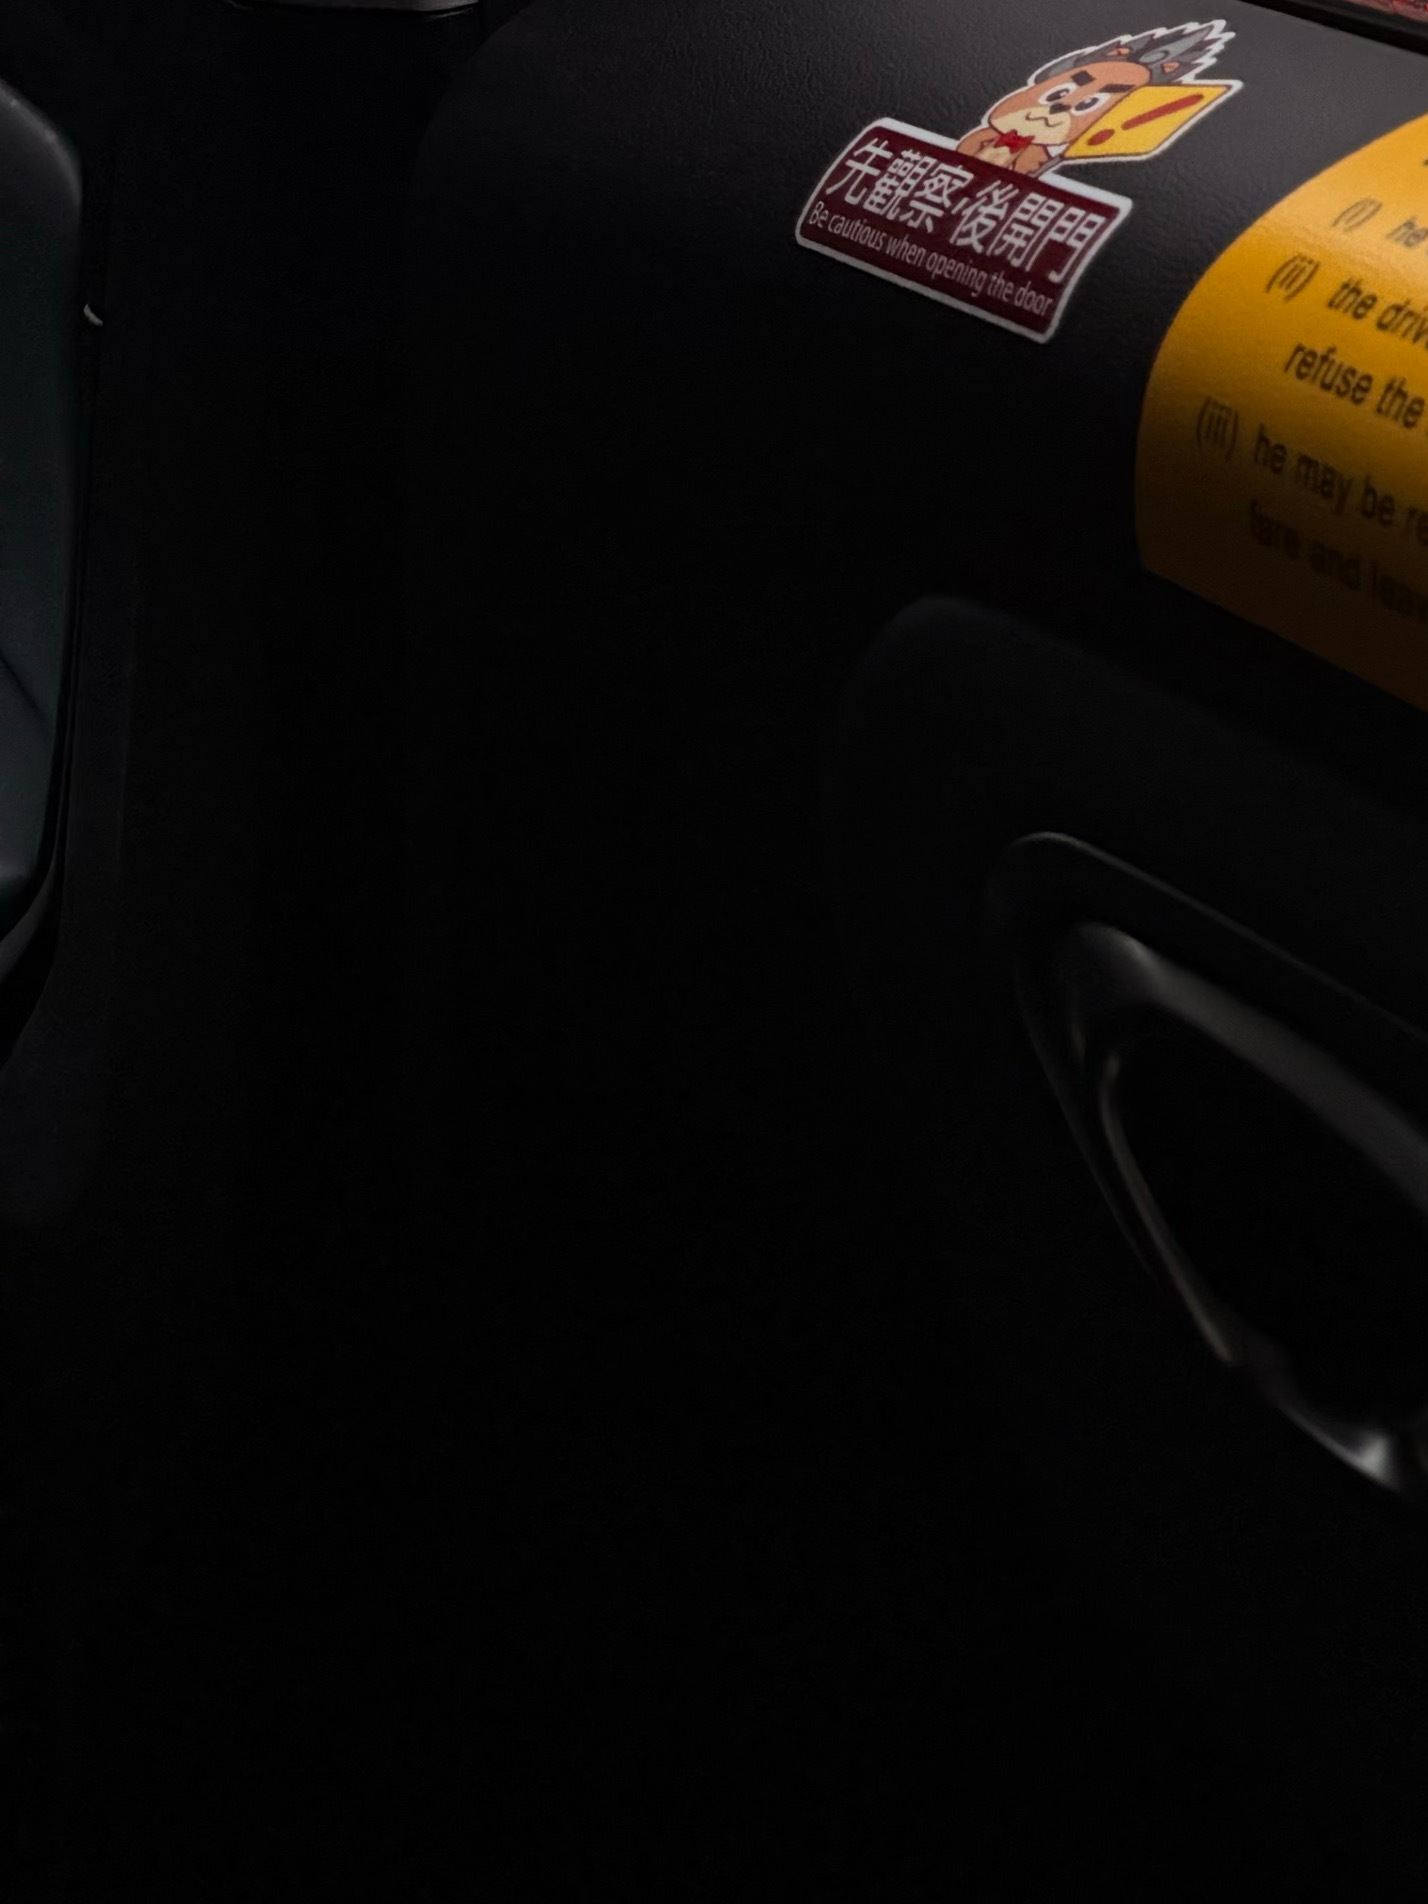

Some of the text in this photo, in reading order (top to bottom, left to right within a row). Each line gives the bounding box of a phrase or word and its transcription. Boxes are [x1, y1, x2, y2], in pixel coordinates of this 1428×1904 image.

[808, 201, 1054, 318] Be cautious when opening the door
[1266, 252, 1321, 302] (ii)
[1327, 275, 1379, 322] the
[1282, 339, 1375, 406] refuse
[1374, 369, 1427, 430] the
[1196, 398, 1239, 462] (iii)
[1253, 422, 1287, 474] he
[1294, 451, 1354, 516] may
[1358, 478, 1397, 528] be
[1247, 496, 1301, 561] fare
[1308, 540, 1362, 592] and
